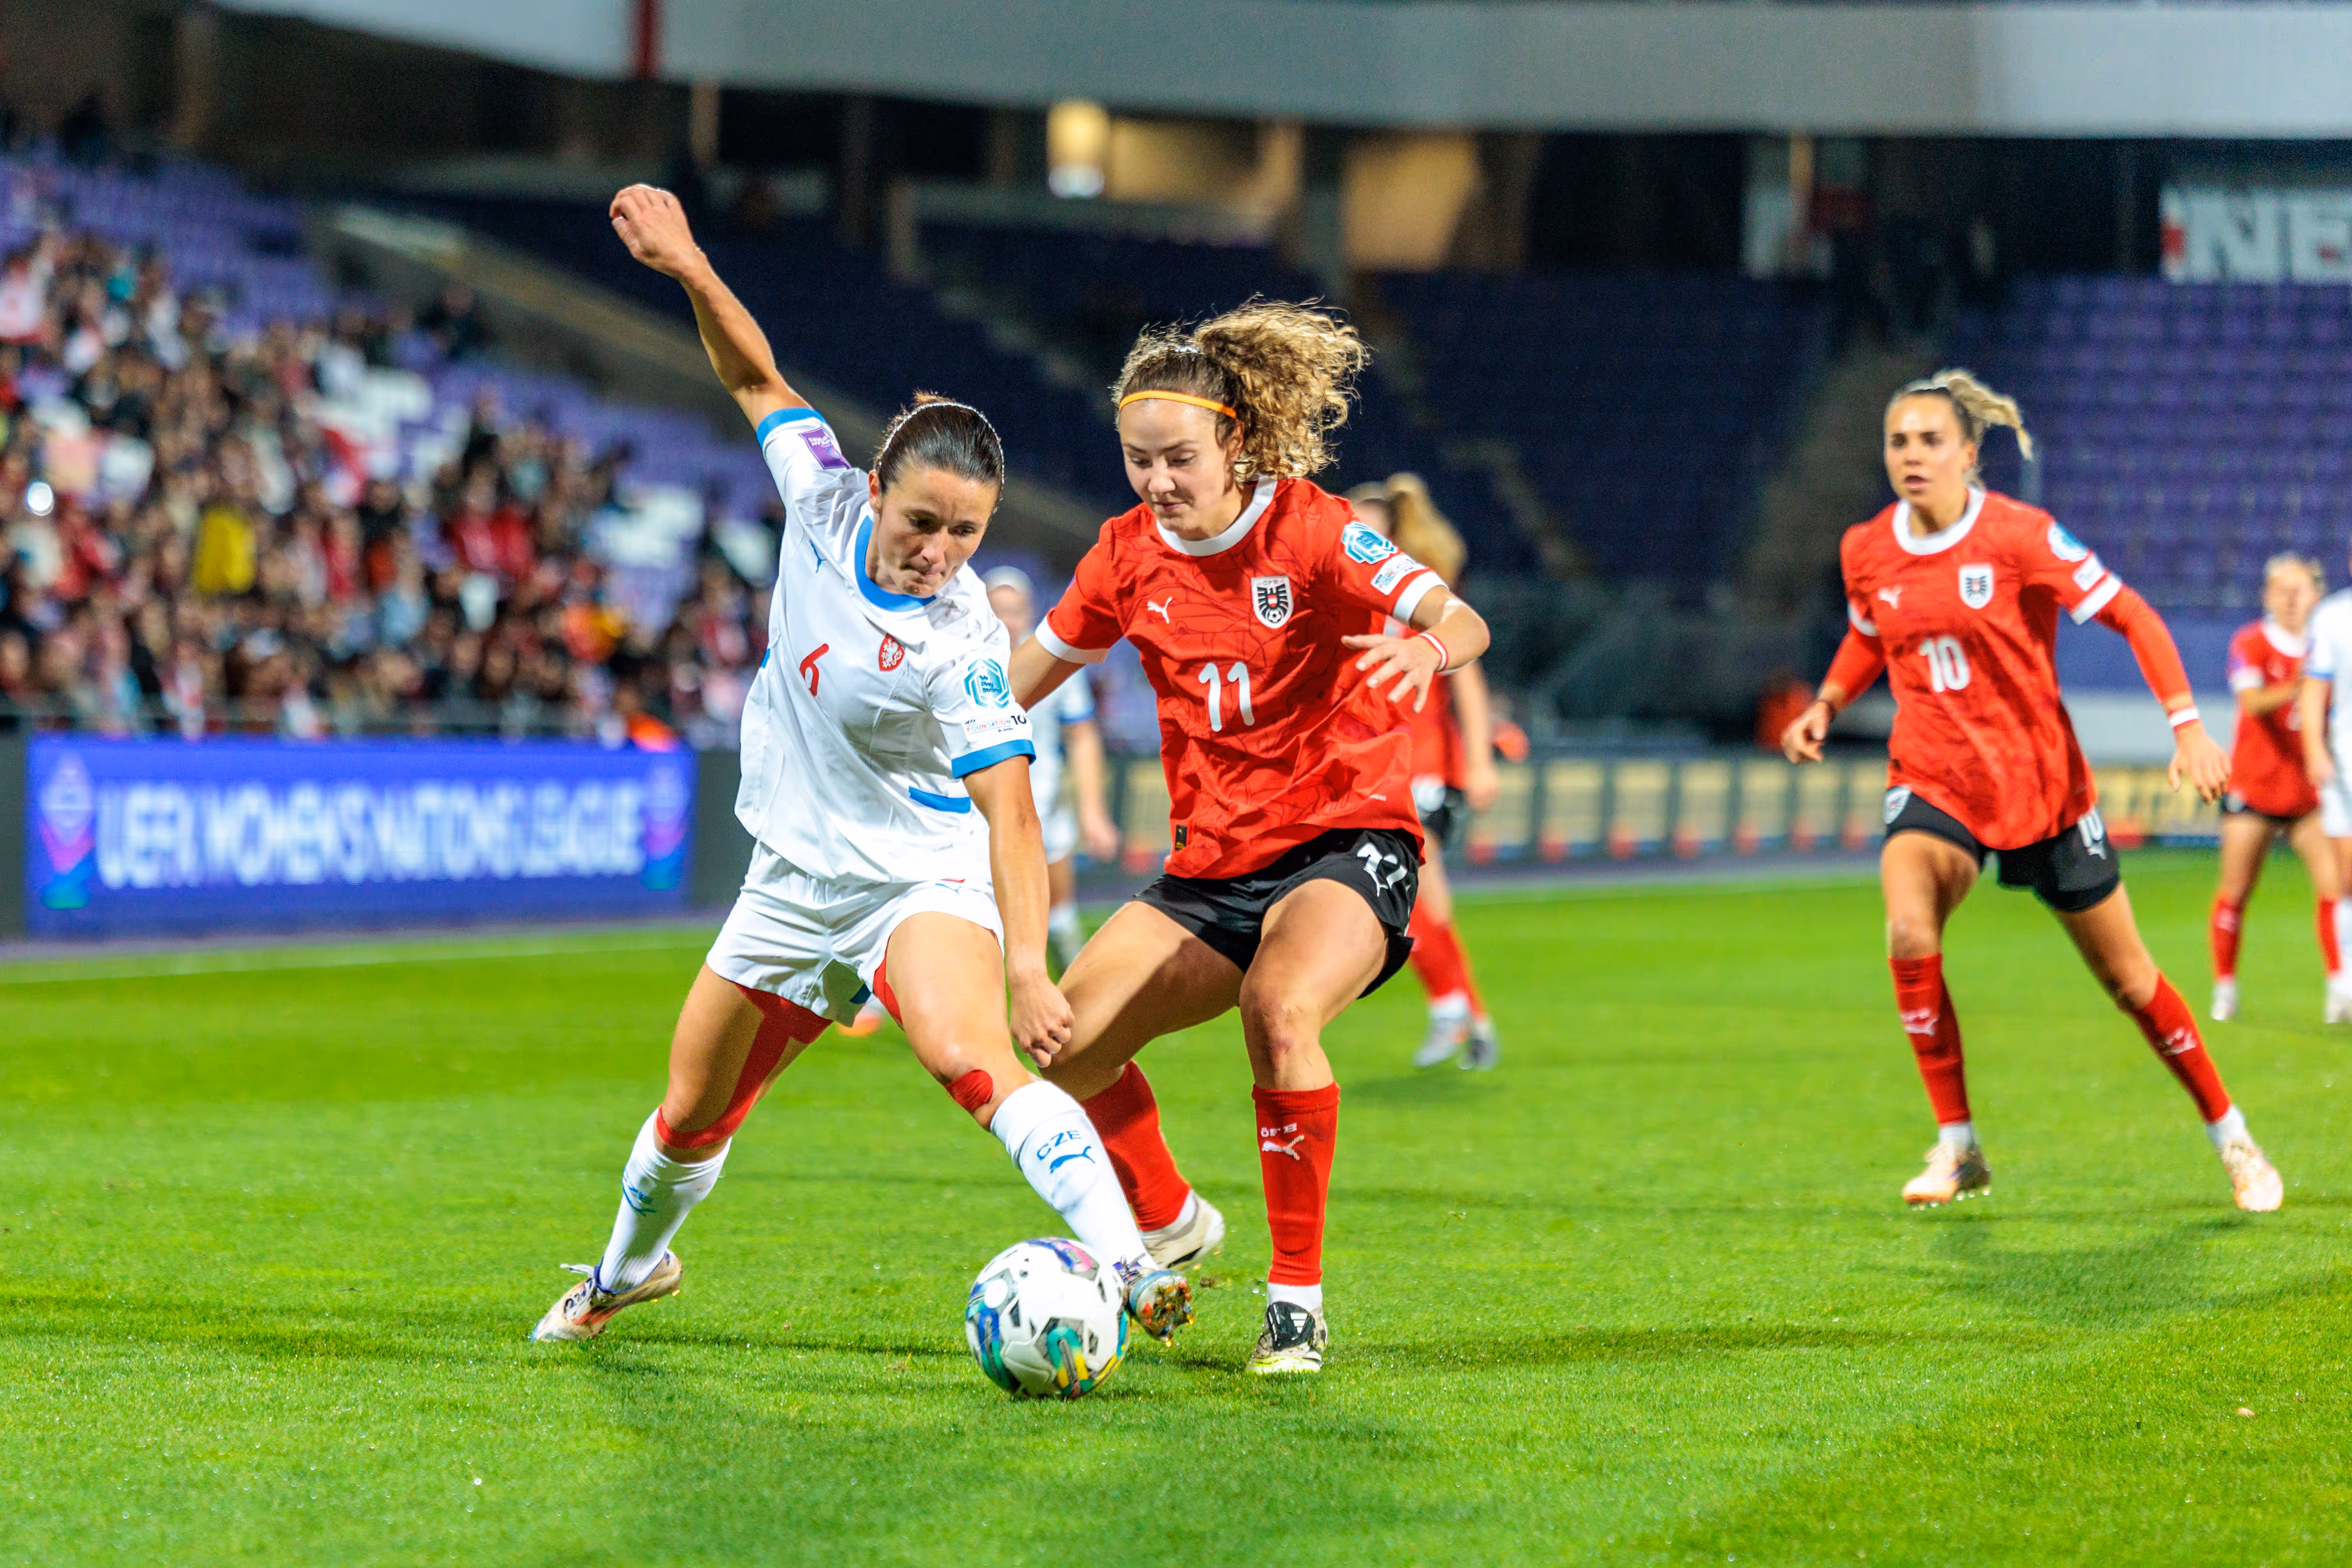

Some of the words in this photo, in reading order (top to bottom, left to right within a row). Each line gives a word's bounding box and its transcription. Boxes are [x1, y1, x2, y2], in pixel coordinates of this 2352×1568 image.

[799, 643, 829, 697] 6
[1919, 636, 1971, 692] 10
[1199, 661, 1255, 732] 11
[967, 720, 1011, 732] FOUNDATION
[1037, 1130, 1081, 1161] CZE
[1261, 1122, 1297, 1137] ÖFB
